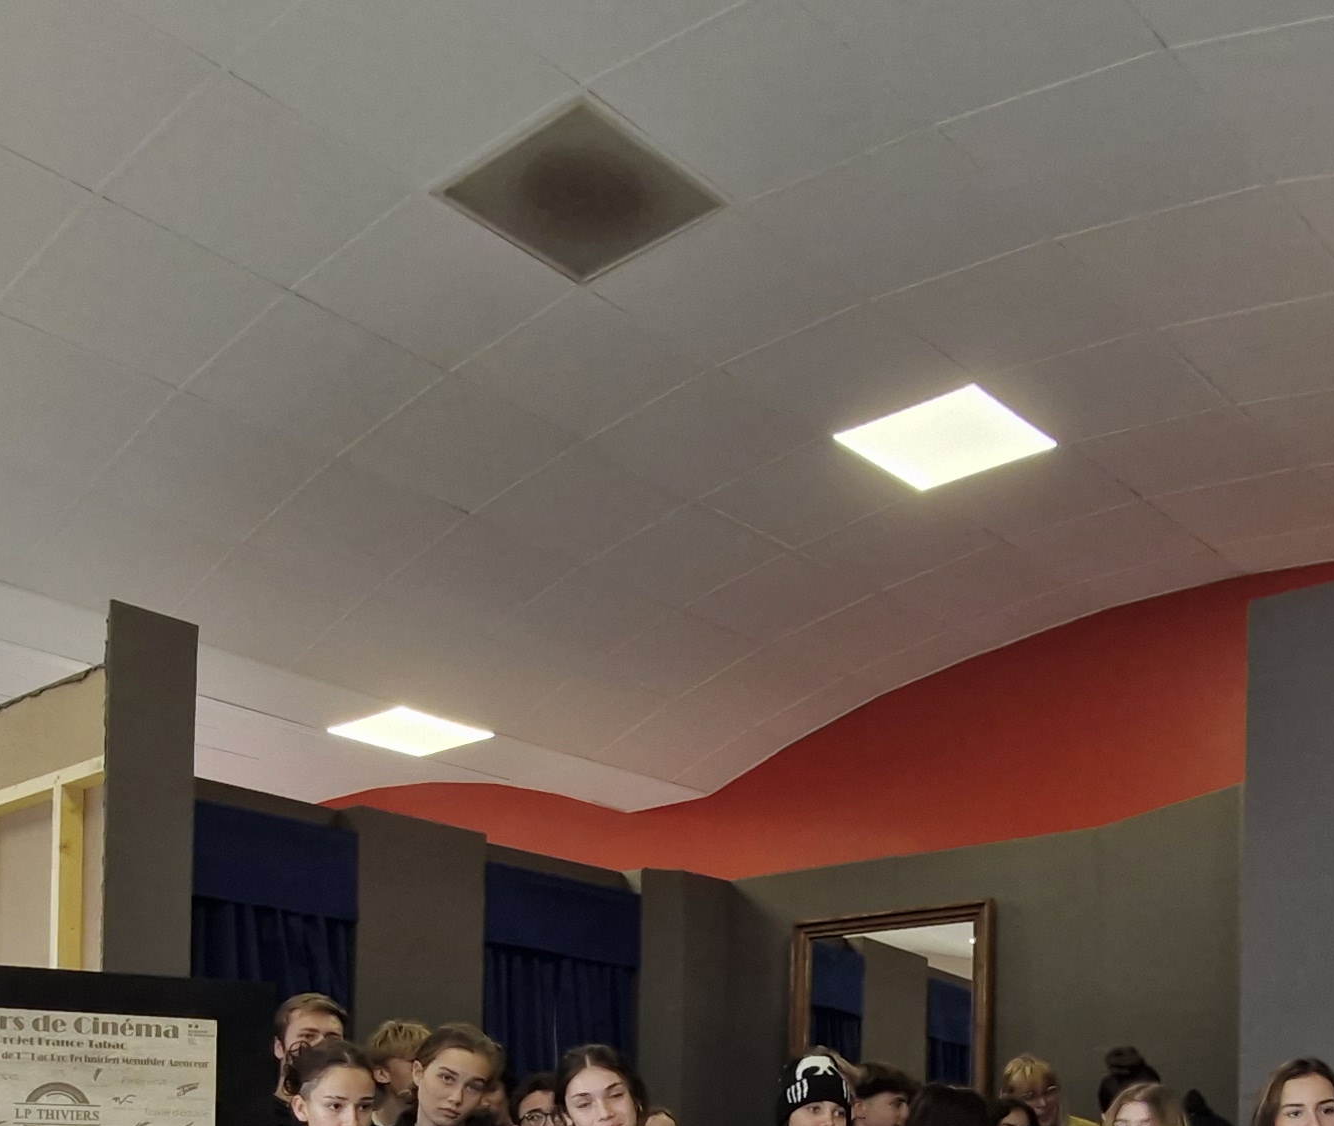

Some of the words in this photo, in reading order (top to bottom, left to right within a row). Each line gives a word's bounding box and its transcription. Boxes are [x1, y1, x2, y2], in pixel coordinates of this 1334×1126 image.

[31, 1015, 67, 1033] de
[73, 1016, 179, 1039] Cinéma
[38, 1036, 84, 1048] France
[88, 1039, 127, 1050] Tabac
[1, 1051, 14, 1060] de
[69, 1054, 120, 1064] Technicien
[122, 1057, 165, 1067] Menuisier
[14, 1107, 32, 1119] LP
[36, 1108, 100, 1121] THIVIERS
